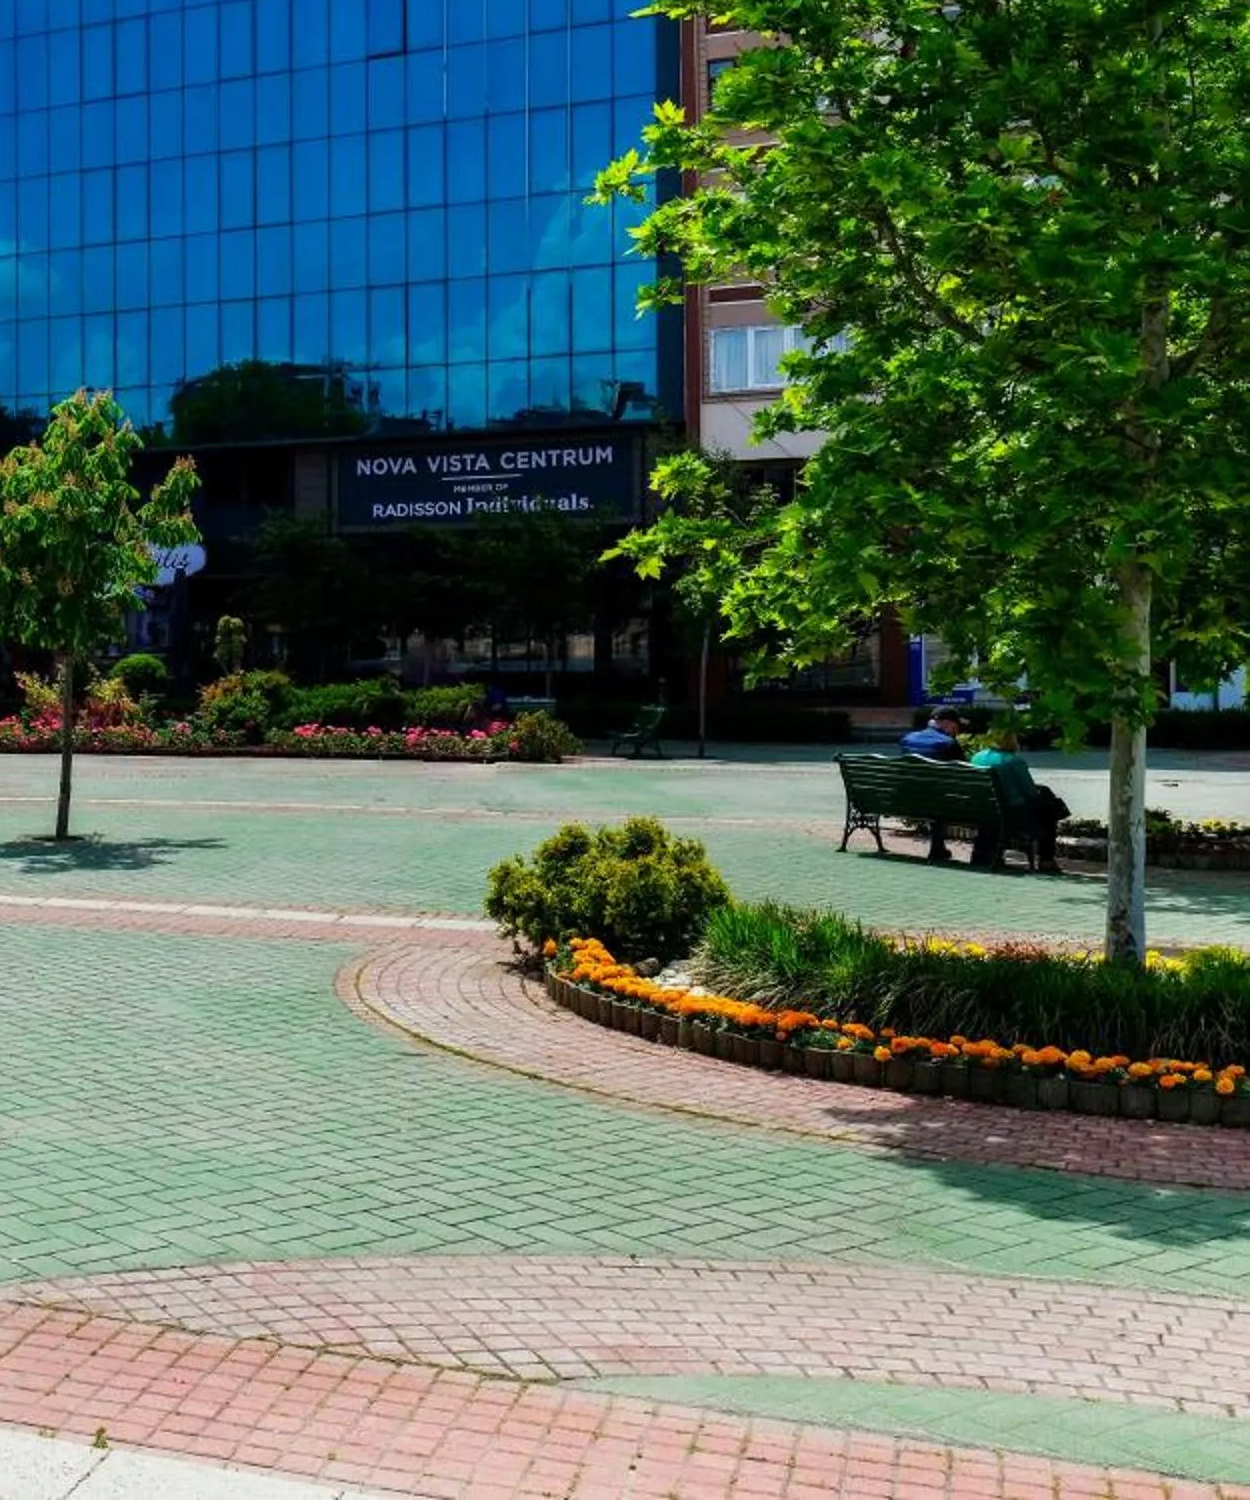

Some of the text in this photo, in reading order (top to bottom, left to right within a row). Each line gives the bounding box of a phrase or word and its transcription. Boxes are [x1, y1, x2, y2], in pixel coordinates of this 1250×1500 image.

[356, 445, 614, 477] NOVA VISTA CENTRUM
[372, 500, 462, 519] RADISSON
